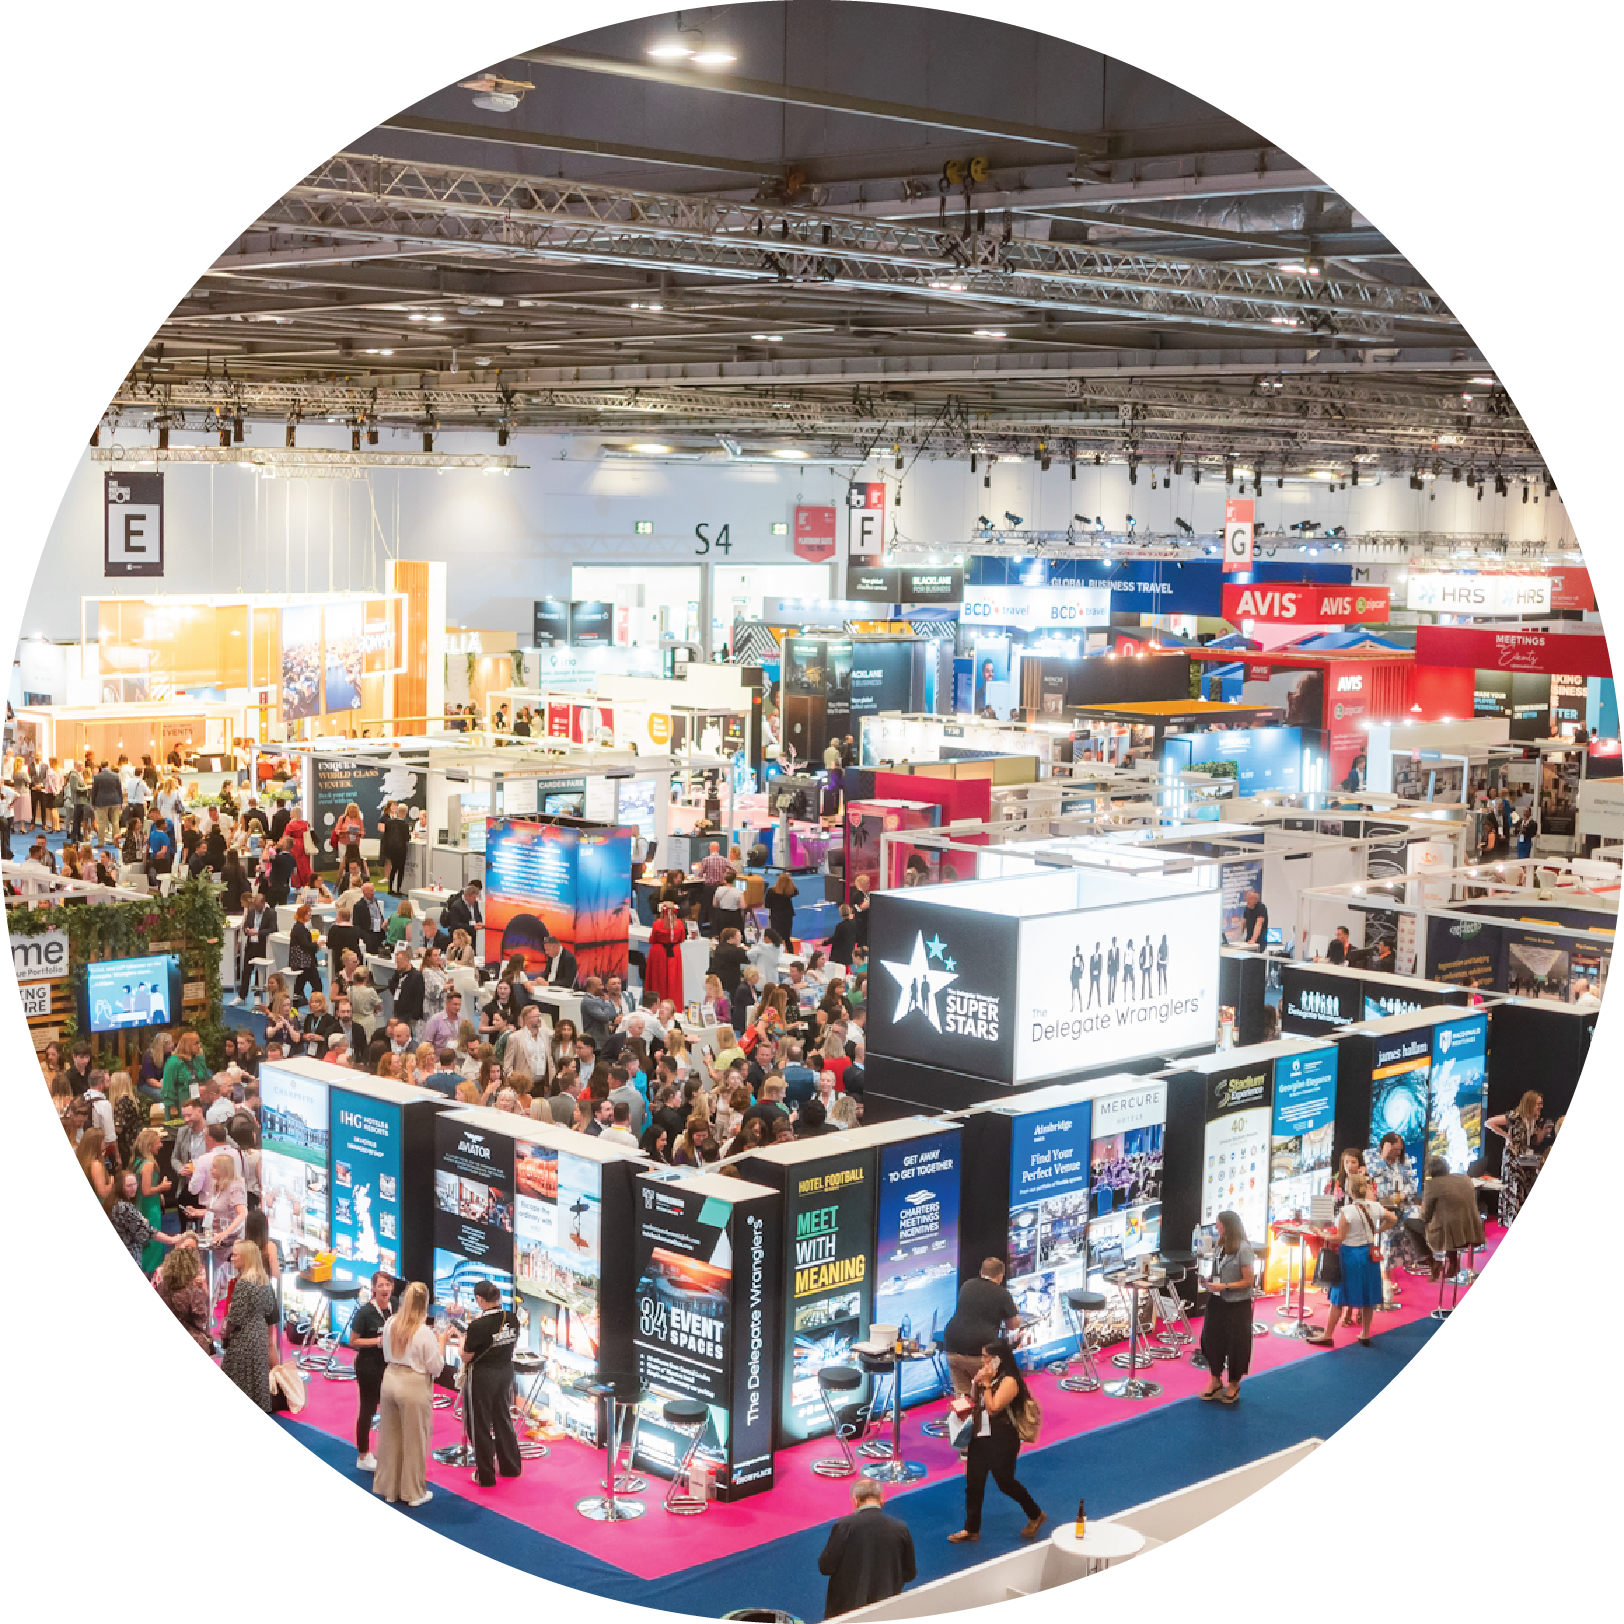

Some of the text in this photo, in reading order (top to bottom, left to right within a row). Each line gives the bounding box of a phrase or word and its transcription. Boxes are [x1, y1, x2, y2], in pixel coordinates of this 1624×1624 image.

[125, 514, 146, 552] E
[695, 523, 733, 555] S4
[860, 517, 874, 547] F
[1232, 529, 1246, 556] G
[912, 576, 952, 584] BLACKLANE
[1051, 577, 1174, 594] GLOBAL BUSINESS TRAVEL
[1236, 590, 1297, 618] AVIS
[1442, 586, 1486, 604] HRS
[1516, 588, 1545, 604] HRS
[964, 602, 1031, 616] BCD travel
[1050, 606, 1076, 619] BCD
[1320, 597, 1351, 615] AVIS
[1495, 634, 1546, 646] MEETINGS
[1250, 666, 1268, 674] AVIS
[1337, 675, 1363, 691] AVIS
[28, 967, 64, 976] Portfolio
[946, 995, 999, 1021] SUPER
[1033, 1009, 1048, 1018] The
[946, 1013, 999, 1041] STARS
[1033, 998, 1198, 1041] Delegate Wranglers
[1229, 1075, 1265, 1092] Stadium
[1101, 1092, 1160, 1115] MERCURE
[340, 1110, 363, 1128] IHG
[1034, 1120, 1073, 1135] Aimbridge
[457, 1141, 491, 1159] AVIATOR
[904, 1149, 940, 1166] GET AWAY
[1031, 1148, 1073, 1166] Find Your
[799, 1167, 864, 1193] HOTEL FOOTBALL
[888, 1159, 953, 1183] TO GET TOGETHER
[1022, 1161, 1081, 1183] Perfect Venue
[900, 1202, 940, 1218] CHARTERS
[797, 1205, 839, 1236] MEET
[900, 1212, 940, 1230] MEETINGS
[900, 1222, 940, 1239] INCENTIVES
[796, 1233, 836, 1264] WITH
[795, 1254, 866, 1294] MEANING
[671, 1306, 724, 1342] EVENT
[747, 1218, 765, 1426] The Delegate Wranglers
[670, 1330, 724, 1359] SPACES
